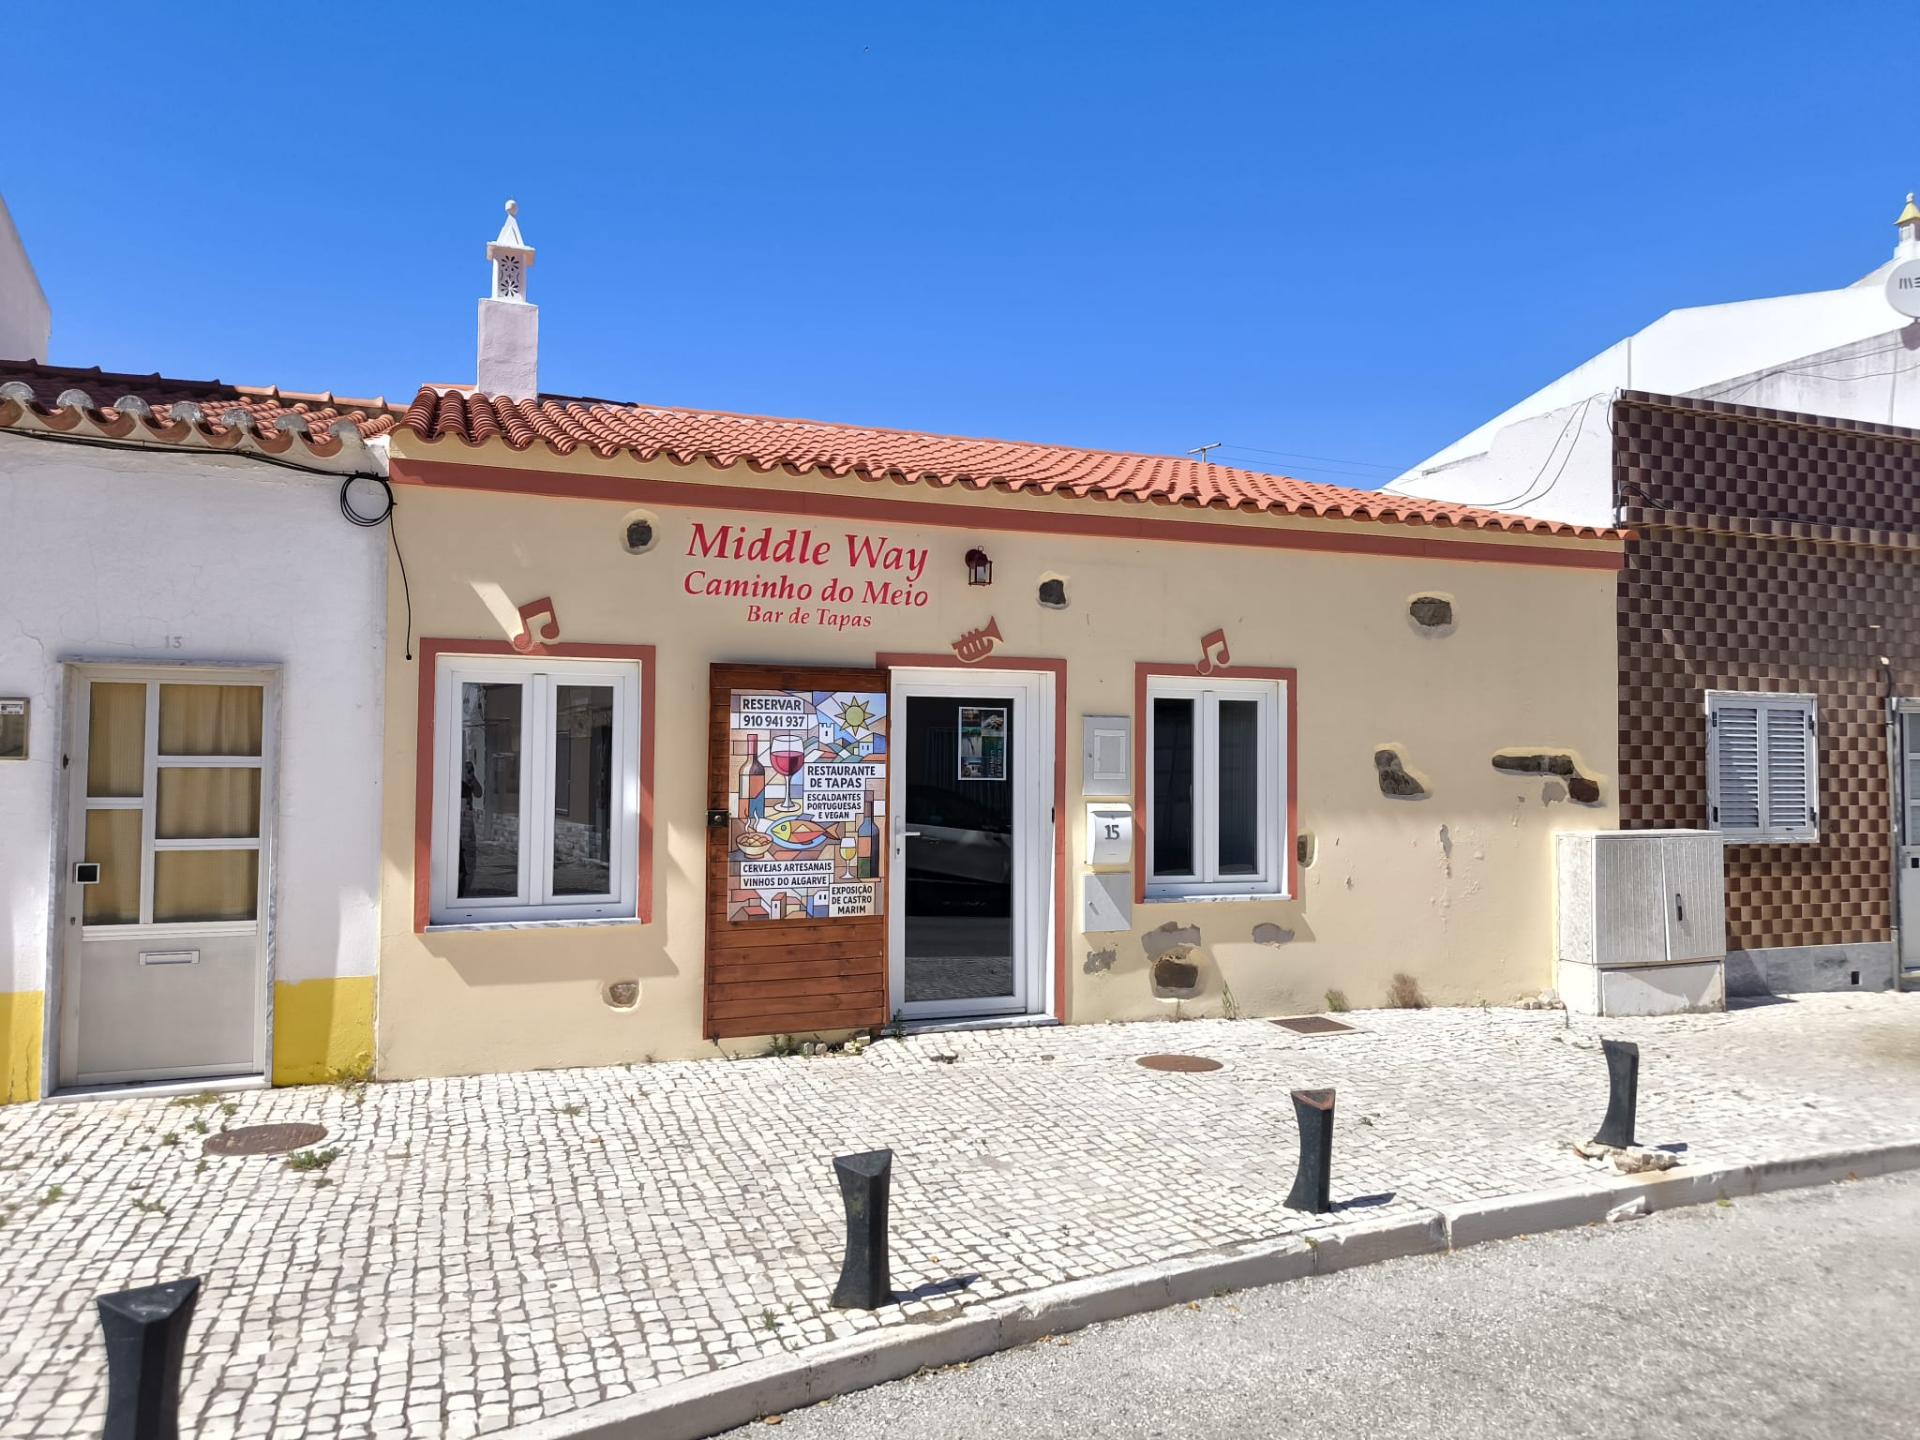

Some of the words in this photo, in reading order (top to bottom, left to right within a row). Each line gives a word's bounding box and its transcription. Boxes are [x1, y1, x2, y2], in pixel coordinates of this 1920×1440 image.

[685, 523, 830, 565] Middle
[844, 534, 928, 582] Way
[684, 570, 812, 601] Caminho
[821, 578, 854, 603] do
[861, 580, 928, 606] Meio
[747, 605, 784, 623] Bar
[788, 607, 810, 624] de
[816, 608, 872, 631] Tapas
[743, 699, 801, 711] RESERVAR
[743, 715, 765, 727] 910
[765, 715, 784, 727] 941
[786, 716, 805, 728] 937
[807, 765, 876, 776] RESTAURANTE
[810, 778, 822, 789] DE
[825, 778, 862, 789] TAPAS
[807, 793, 861, 802] ESCALDANTES
[807, 802, 861, 811] PORTUGUESAS
[818, 811, 823, 819] E
[825, 811, 850, 819] VEGAN
[1104, 824, 1120, 841] 15
[743, 863, 782, 873] CERVEJAS
[784, 862, 832, 872] ARTESANAIS
[743, 876, 775, 887] VINHOS
[777, 876, 789, 886] DO
[792, 875, 827, 885] ALGARVE
[831, 896, 841, 904] DE
[843, 895, 872, 904] CASTRO
[838, 905, 866, 915] MARIM
